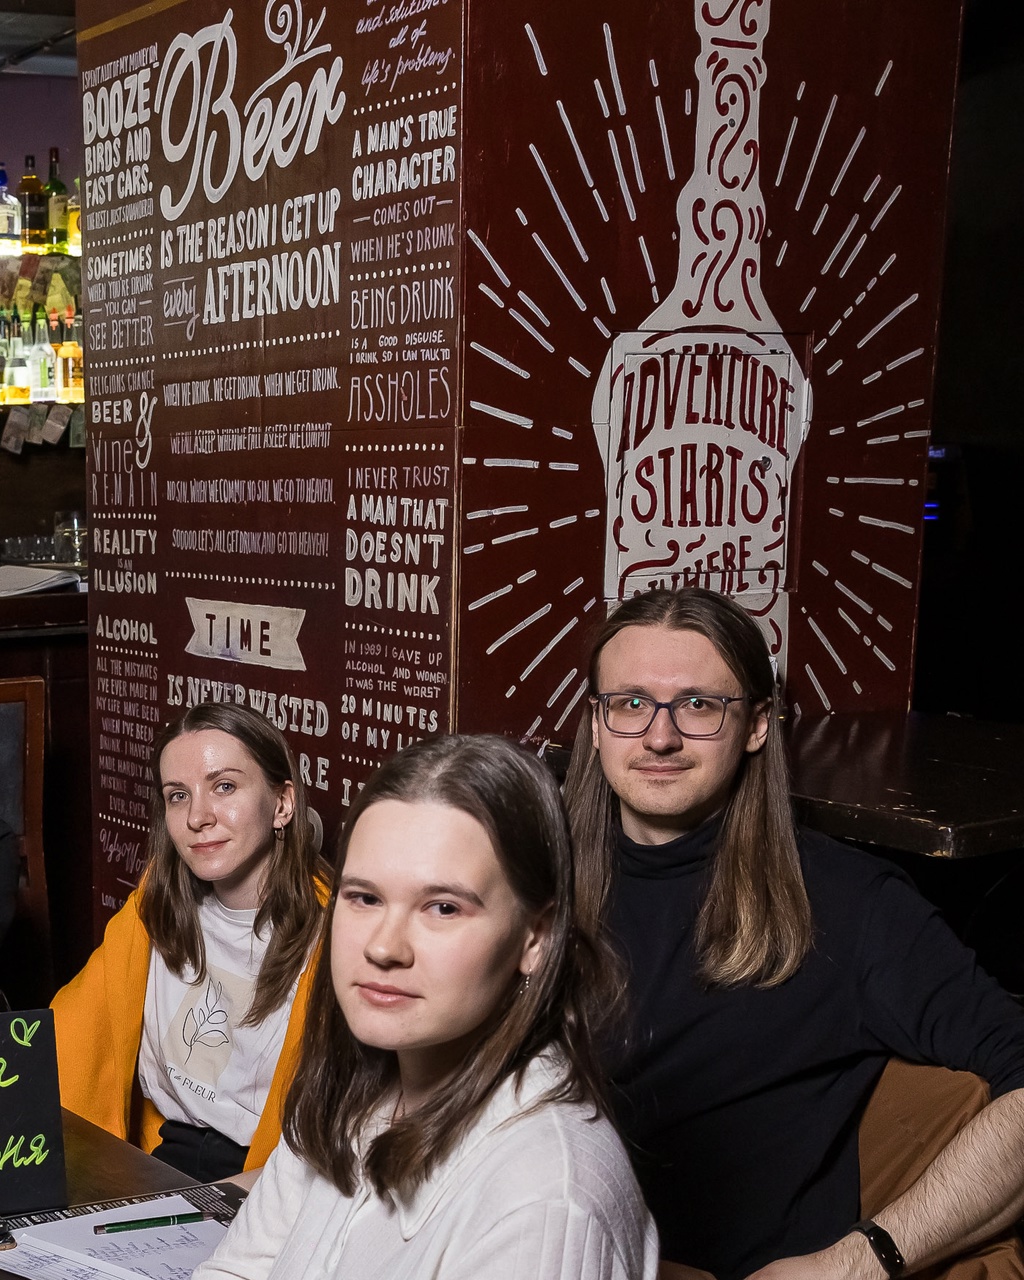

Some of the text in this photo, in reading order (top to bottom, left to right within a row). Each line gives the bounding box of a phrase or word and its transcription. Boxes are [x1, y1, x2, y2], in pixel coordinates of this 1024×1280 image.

[356, 5, 385, 34] and
[389, 19, 426, 49] all of
[361, 44, 455, 96] life's problems.
[83, 67, 151, 145] BOOZE
[154, 9, 346, 221] Beer
[352, 105, 457, 158] A MAN'S TRUE
[85, 127, 151, 177] BIRDS AND
[85, 163, 152, 208] FAST CARS.
[352, 146, 455, 201] CHARACTER
[374, 196, 436, 226] COMES OUT
[160, 187, 340, 269] IS THE REASON I GET UP
[351, 223, 455, 263] WHEN HE'S DRUNK
[87, 244, 152, 280] SOMETIMES
[87, 273, 153, 302] WHEN YOU'RE DRUNK
[163, 242, 341, 341] every AFTERNOON
[351, 276, 454, 329] BEING DRUNK
[105, 298, 136, 316] YOU CAN
[90, 316, 154, 351] SEE BETTER
[352, 330, 445, 350] IS A GOOD DISGUISE.
[350, 348, 450, 364] I DRINK SO I CAN TALK TO
[90, 370, 154, 396] RELIGIONS CHANGE
[181, 382, 191, 406] WE
[214, 378, 223, 401] WE
[224, 377, 237, 400] GET
[238, 374, 263, 400] DRUNK.
[264, 372, 283, 397] WHEN
[285, 371, 296, 396] WE
[296, 370, 310, 392] GET
[312, 366, 341, 392] DRUNK.
[347, 366, 451, 423] ASSHOLES
[92, 399, 132, 424] BEER
[289, 424, 300, 449] WE
[92, 472, 157, 506] REMAIN
[167, 480, 176, 501] NO
[208, 479, 219, 502] WE
[246, 480, 256, 502] NO
[272, 479, 284, 502] WE
[284, 479, 294, 502] GO
[296, 478, 305, 502] TO
[348, 465, 449, 490] I NEVER TRUST
[631, 443, 768, 528] STARTS
[347, 494, 449, 530] A MAN THAT
[94, 528, 157, 555] REALITY
[215, 530, 226, 553] ALL
[227, 530, 239, 553] GET
[260, 531, 276, 554] AND
[277, 531, 288, 554] GO
[288, 531, 297, 555] TO
[346, 528, 444, 569] DOESN'T
[118, 558, 132, 571] IS AN
[94, 569, 157, 594] ILLUSION
[345, 567, 440, 615] DRINK
[96, 614, 157, 645] ALCOHOL
[206, 614, 271, 656] TIME
[344, 640, 443, 666] IN 1989 I GAVE UP
[97, 657, 157, 680] ALL THE MISTAKES
[346, 660, 385, 674] ALCOHOL
[392, 667, 410, 679] AND
[111, 679, 127, 697] EVER
[129, 682, 147, 700] MADE
[150, 686, 157, 701] IN
[346, 678, 441, 698] IT WAS THE WORST
[96, 696, 159, 722] MY LIFE HAVE BEEN
[167, 674, 183, 706] IS
[249, 689, 329, 737] WASTED
[341, 694, 438, 732] 20 MINUTES
[342, 722, 390, 749] OF MY
[182, 1078, 216, 1103] FLEUR
